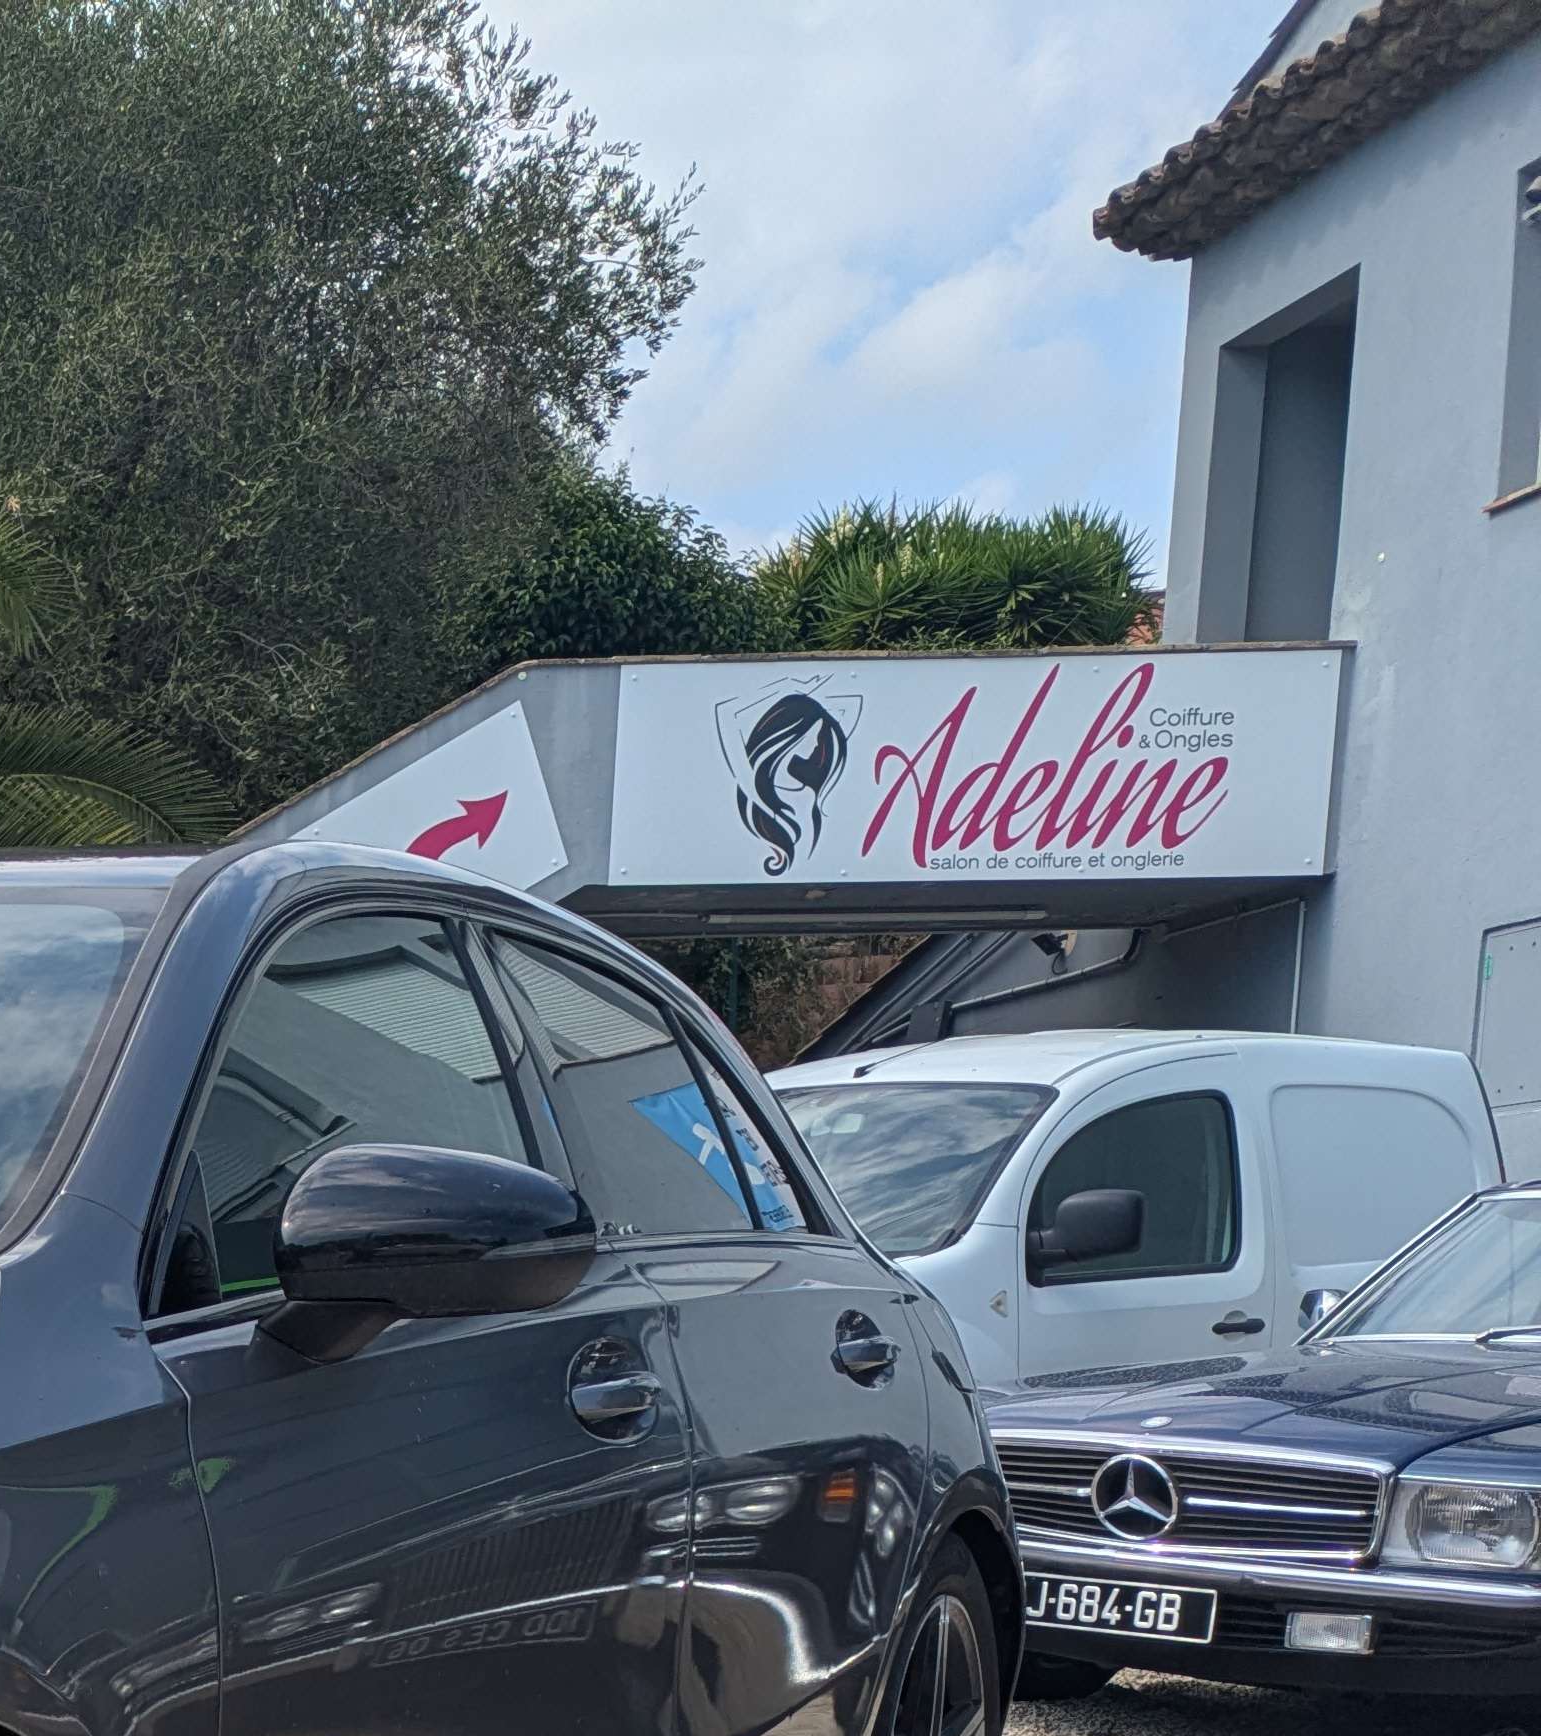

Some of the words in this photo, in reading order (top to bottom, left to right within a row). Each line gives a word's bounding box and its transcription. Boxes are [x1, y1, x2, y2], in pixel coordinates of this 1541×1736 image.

[1148, 706, 1236, 729] Coiffure
[1138, 734, 1151, 749] &
[1153, 729, 1235, 753] Ongles
[861, 662, 1230, 869] Adeline
[929, 853, 979, 870] salon
[985, 852, 1009, 870] de
[1015, 850, 1081, 869] coiffure
[1088, 851, 1104, 868] et
[1110, 848, 1185, 871] onglerie
[1025, 1580, 1182, 1632] J-684-GB
